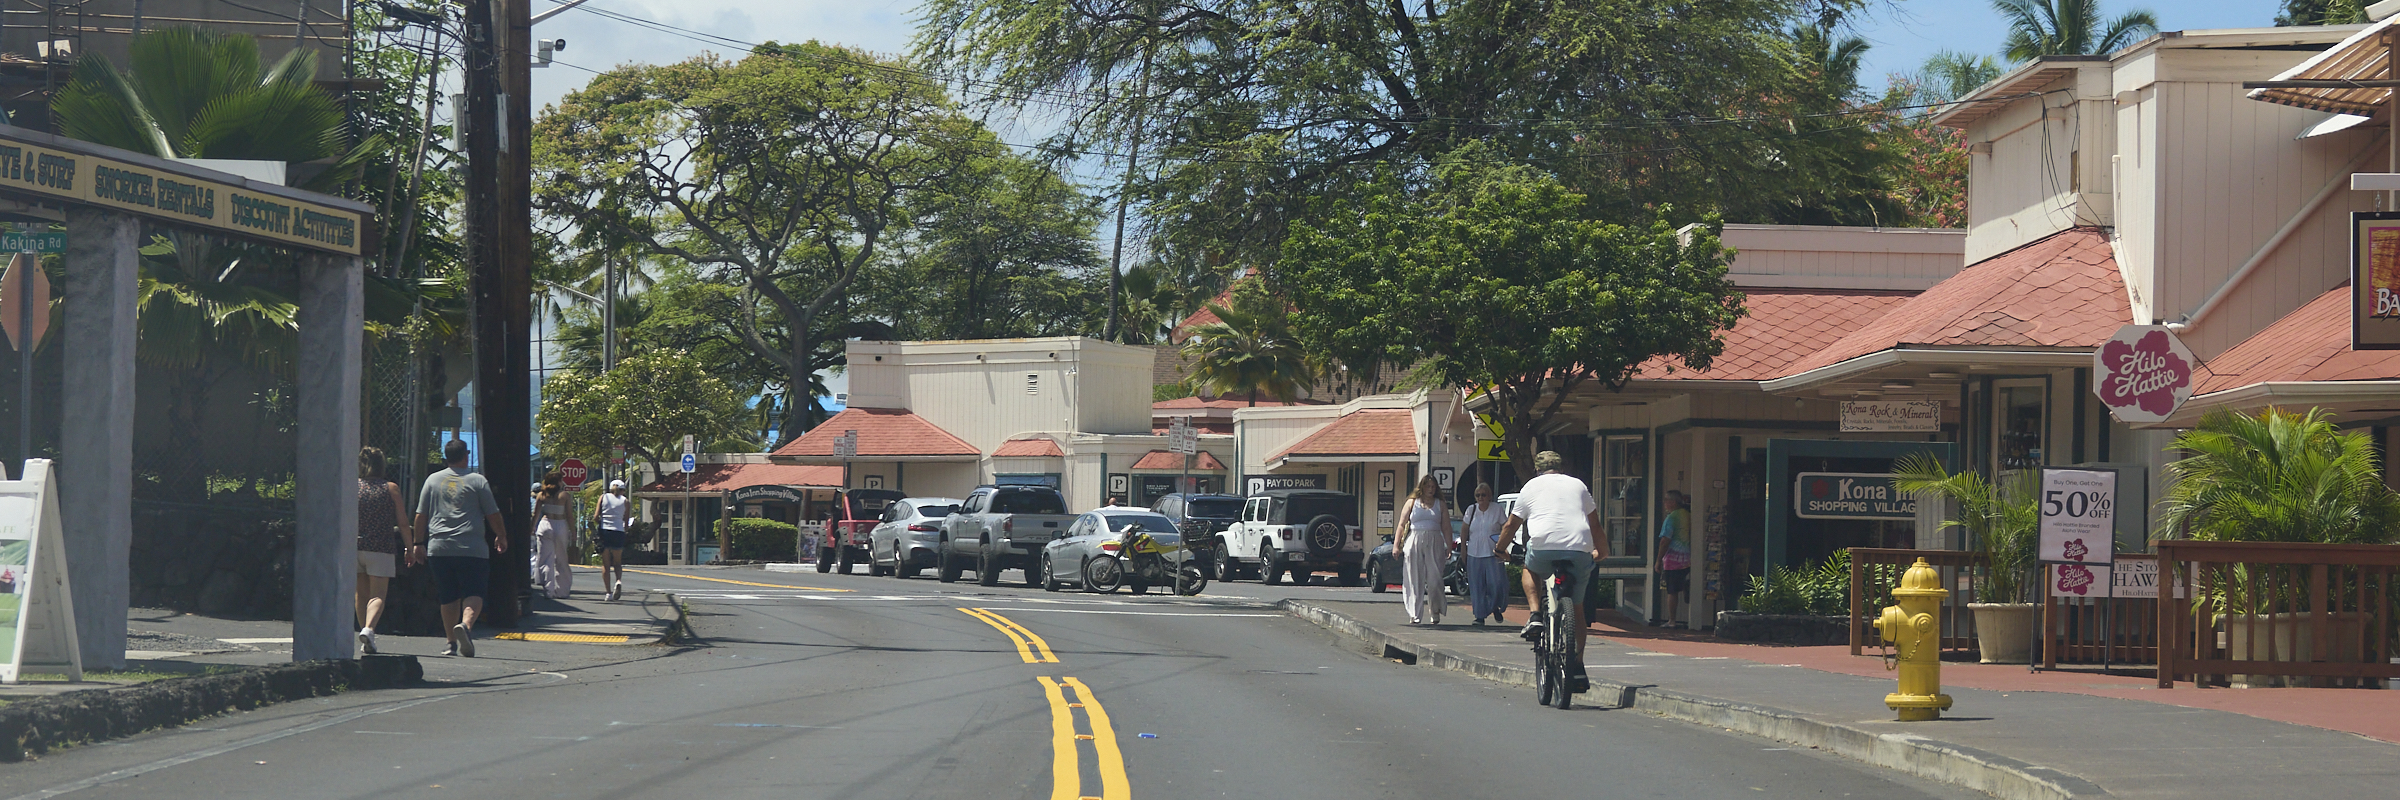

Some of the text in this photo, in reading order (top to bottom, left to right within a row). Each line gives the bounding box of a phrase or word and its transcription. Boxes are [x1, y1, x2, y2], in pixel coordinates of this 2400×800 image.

[0, 144, 76, 190] VE & SURF
[95, 165, 214, 219] SNORKEL RENTALS
[231, 193, 355, 248] DISCOUNT ACTIVITIES
[2, 236, 61, 250] Kakina Rd
[2120, 350, 2166, 375] Hilo
[2115, 369, 2179, 397] Hattie
[1846, 402, 1935, 419] Kona Rock & Mineral
[561, 466, 585, 478] STOP
[870, 480, 879, 488] P
[1115, 479, 1123, 489] P
[1266, 478, 1315, 487] PAY TO PARK
[1383, 476, 1390, 487] P
[1439, 473, 1448, 485] P
[735, 487, 800, 502] Kona Inn Shopping Village
[1253, 483, 1260, 494] P
[1839, 478, 1887, 501] Kona
[1809, 500, 1916, 513] SHOPPING VILLAG
[2043, 490, 2111, 518] 50%
[2089, 509, 2111, 518] OFF
[2067, 549, 2086, 557] Hattie
[2068, 543, 2082, 551] Hilo
[2136, 561, 2158, 572] STO
[2065, 568, 2084, 580] Hilo
[2063, 575, 2090, 588] Hattie
